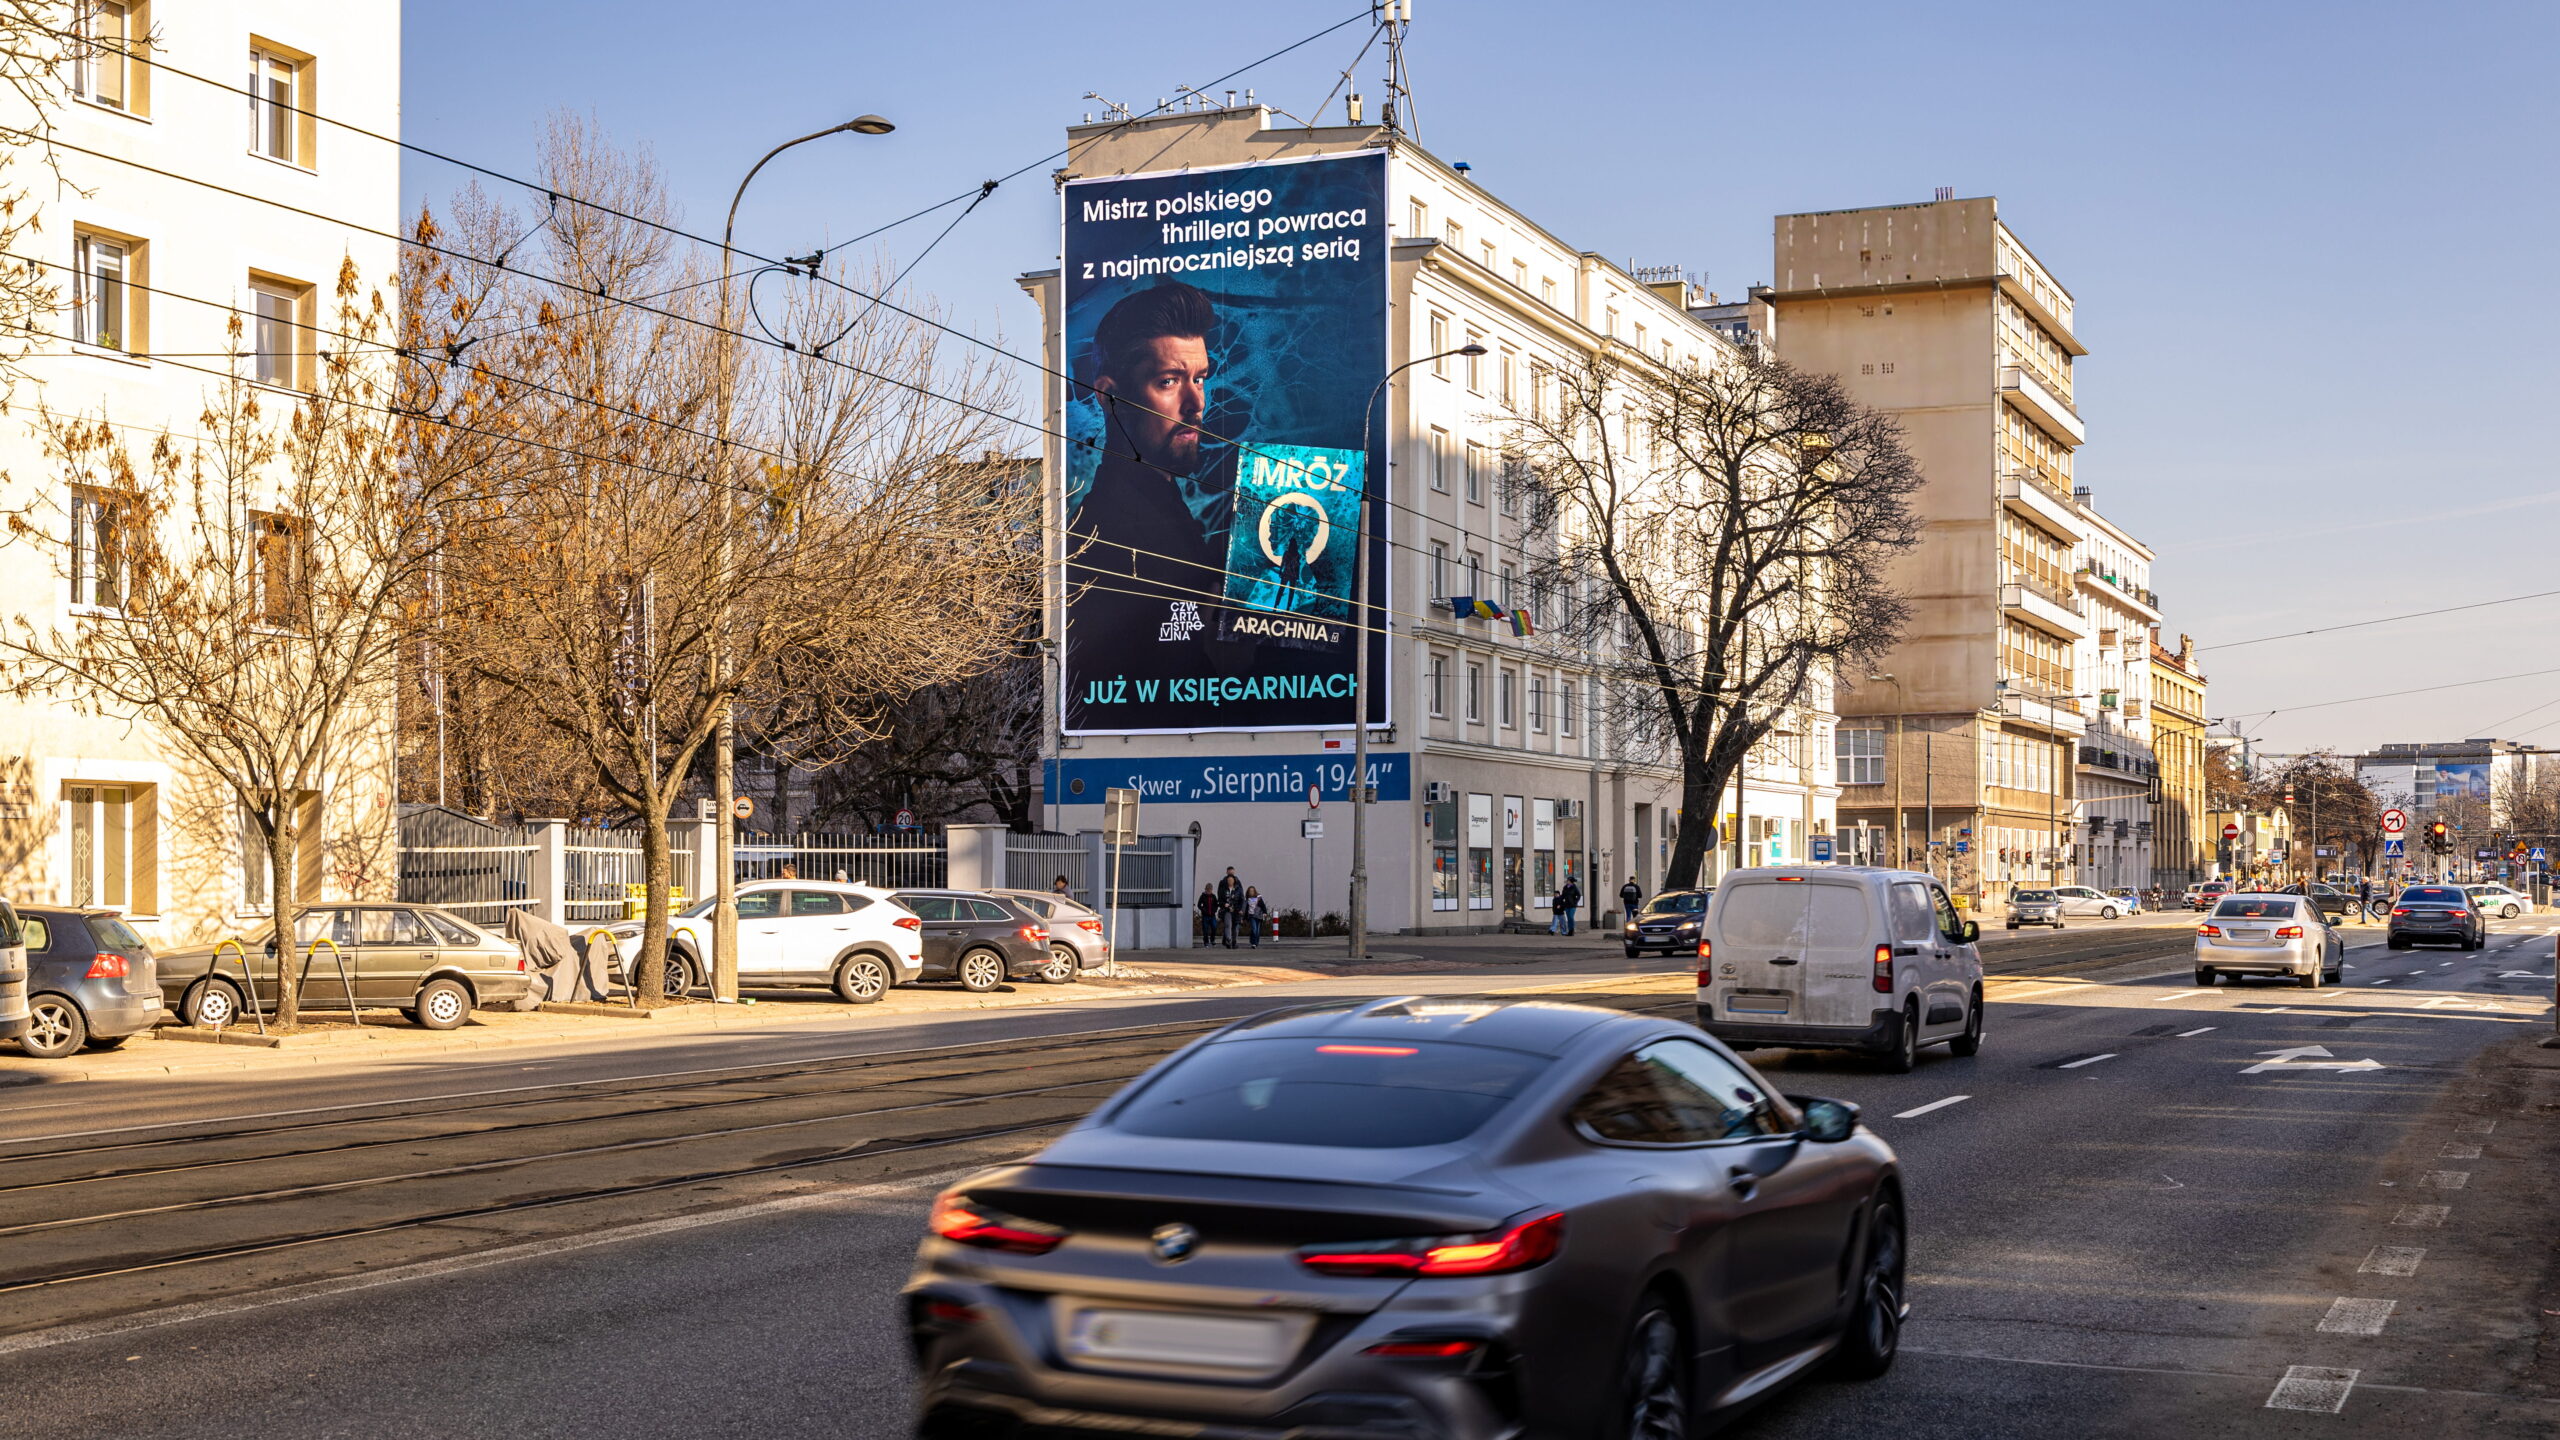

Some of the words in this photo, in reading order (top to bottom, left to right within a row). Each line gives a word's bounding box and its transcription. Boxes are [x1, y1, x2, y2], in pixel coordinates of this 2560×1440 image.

[1083, 198, 1147, 222] Mistrz
[1155, 188, 1272, 221] polskiego
[1162, 219, 1250, 245] thrillera
[1258, 208, 1366, 240] powraca
[1083, 262, 1094, 279] z
[1102, 245, 1293, 280] najmroczniejszą
[1301, 236, 1360, 261] serią
[1171, 611, 1200, 621] ARTA
[1233, 616, 1329, 642] ARACHNIA
[1173, 632, 1191, 641] NA
[1083, 675, 1127, 704] JUŻ
[1135, 679, 1160, 703] W
[1128, 775, 1182, 795] Skwer
[899, 815, 910, 825] 20
